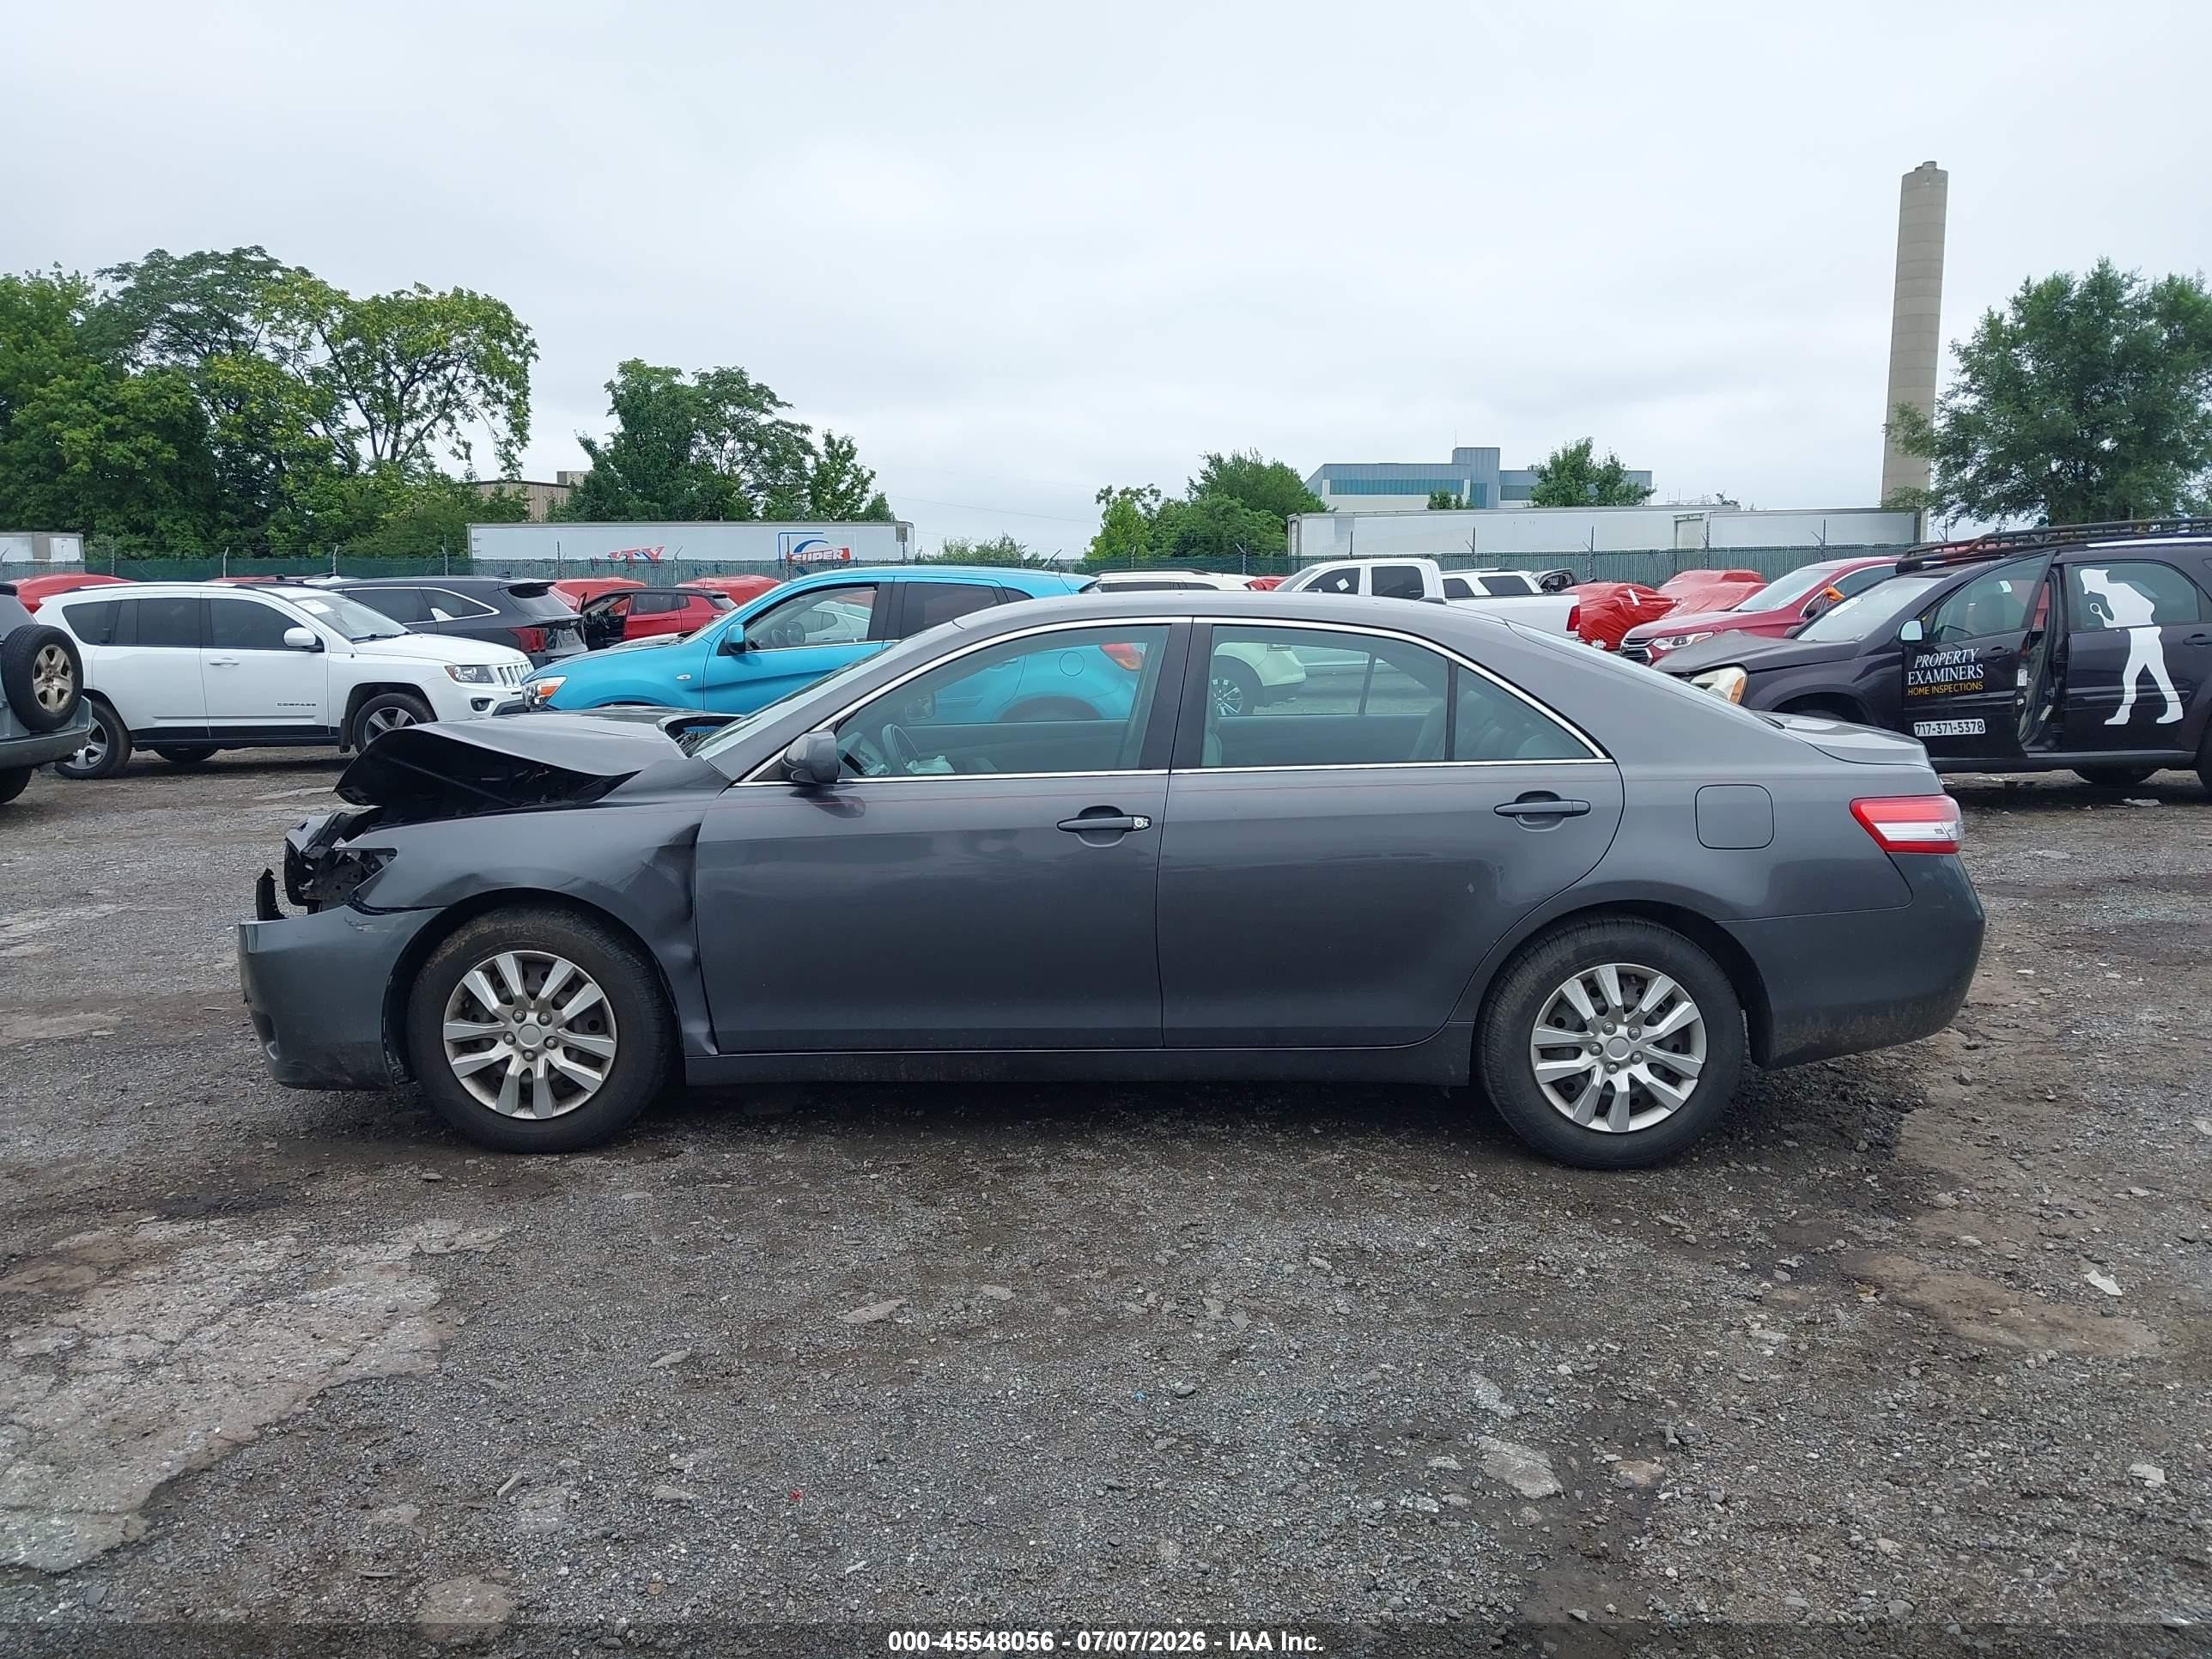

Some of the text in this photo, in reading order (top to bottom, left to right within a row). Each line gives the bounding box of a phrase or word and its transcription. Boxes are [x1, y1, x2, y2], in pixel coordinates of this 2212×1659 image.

[1914, 648, 1979, 669] PROPERTY
[1908, 664, 1984, 685] EXAMINERS
[1908, 682, 1984, 696] HOME INSPECTIONS
[1915, 720, 1984, 734] 717-371-5378
